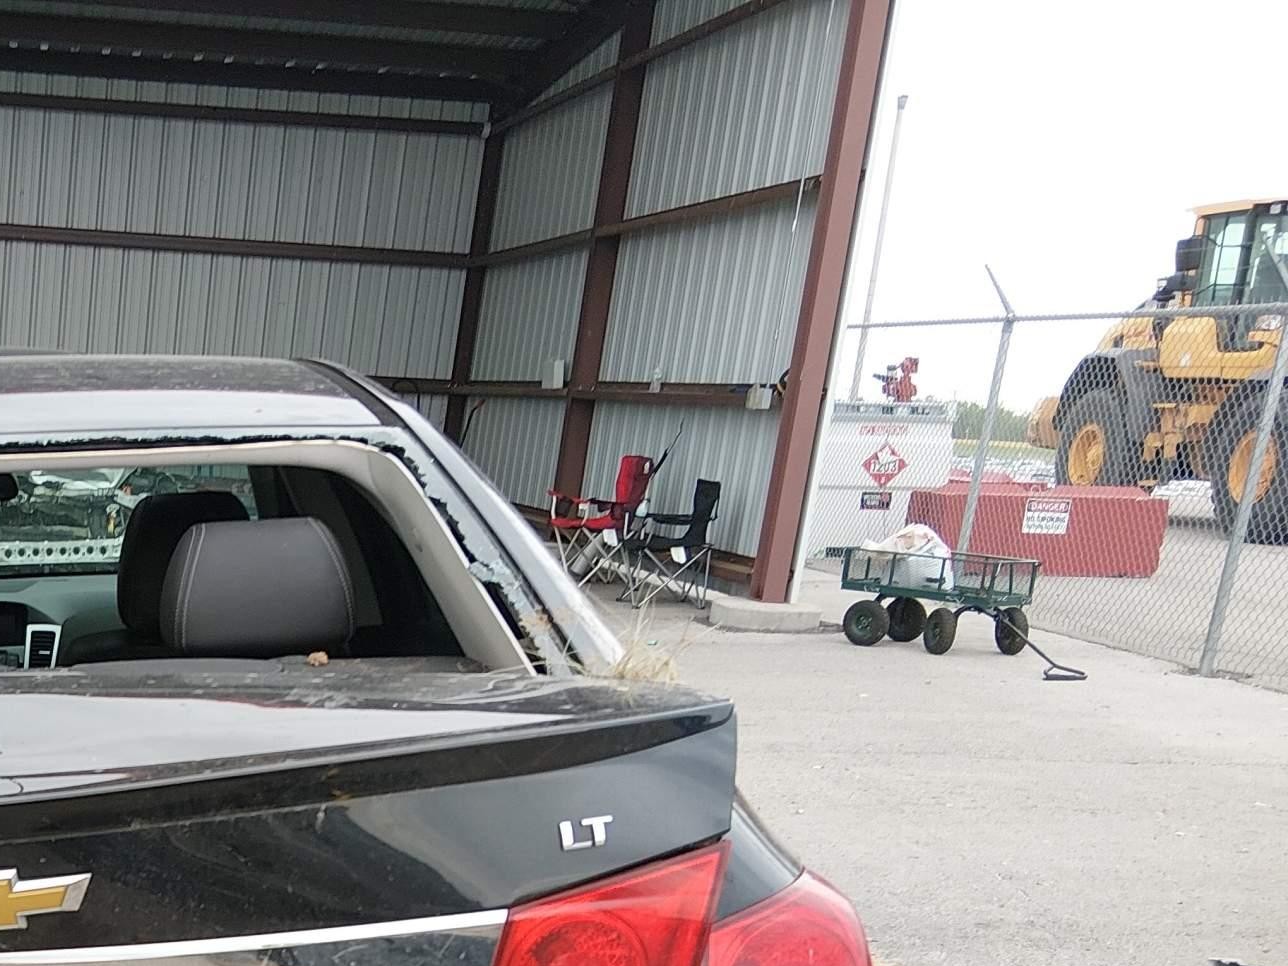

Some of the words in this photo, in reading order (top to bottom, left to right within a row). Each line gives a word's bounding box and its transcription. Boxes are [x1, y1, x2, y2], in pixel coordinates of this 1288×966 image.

[871, 460, 897, 473] 1203
[1031, 501, 1068, 512] DANGER
[559, 815, 613, 850] LT
